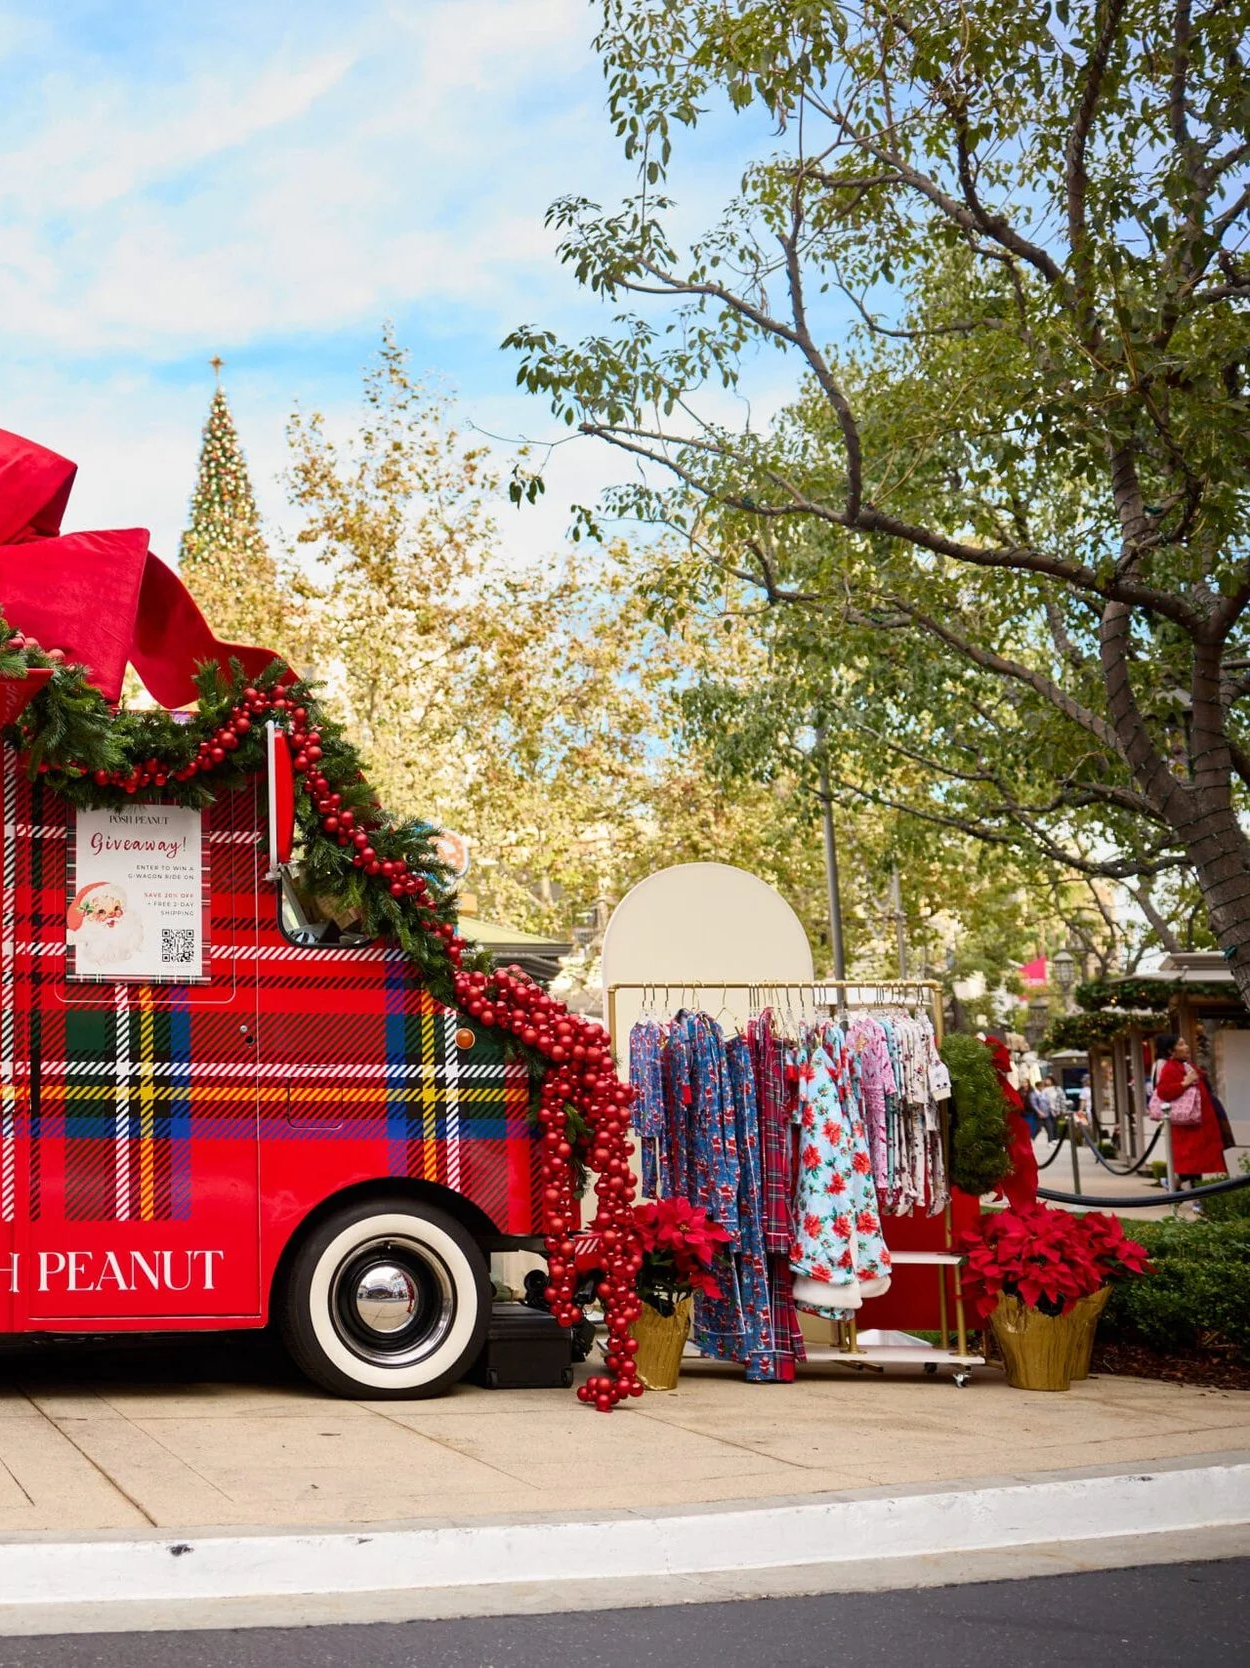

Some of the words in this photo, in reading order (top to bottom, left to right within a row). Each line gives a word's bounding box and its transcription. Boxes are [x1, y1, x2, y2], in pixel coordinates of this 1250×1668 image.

[109, 815, 133, 824] POSH
[135, 816, 169, 825] PEANUT
[91, 832, 186, 859] Giveaway!
[37, 1250, 224, 1291] PEANUT
